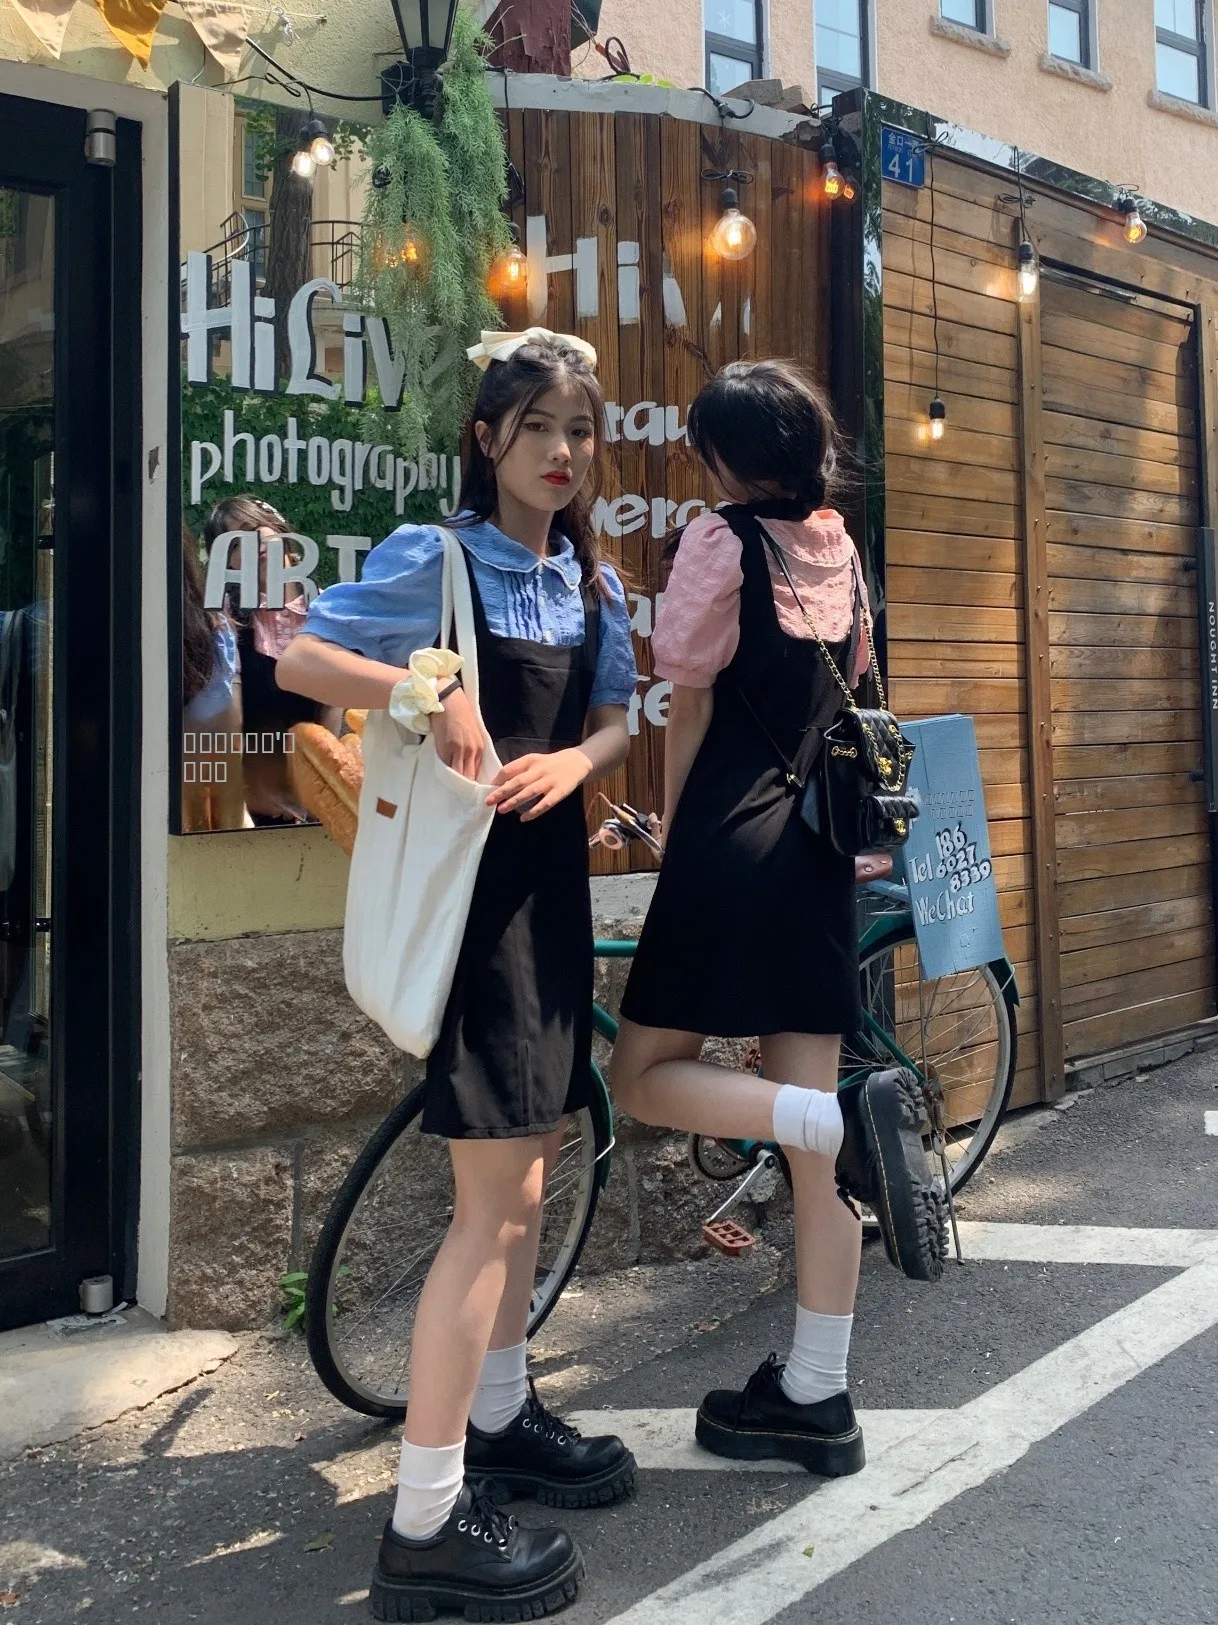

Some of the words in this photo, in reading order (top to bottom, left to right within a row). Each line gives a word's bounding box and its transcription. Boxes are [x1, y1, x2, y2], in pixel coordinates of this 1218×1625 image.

[888, 153, 913, 182] 41
[190, 410, 461, 517] photography
[204, 530, 371, 609] ART
[1208, 602, 1217, 674] NOUGHT
[935, 822, 968, 859] 186
[909, 852, 934, 884] Tel
[936, 842, 977, 878] 6027
[915, 889, 974, 926] WeChat
